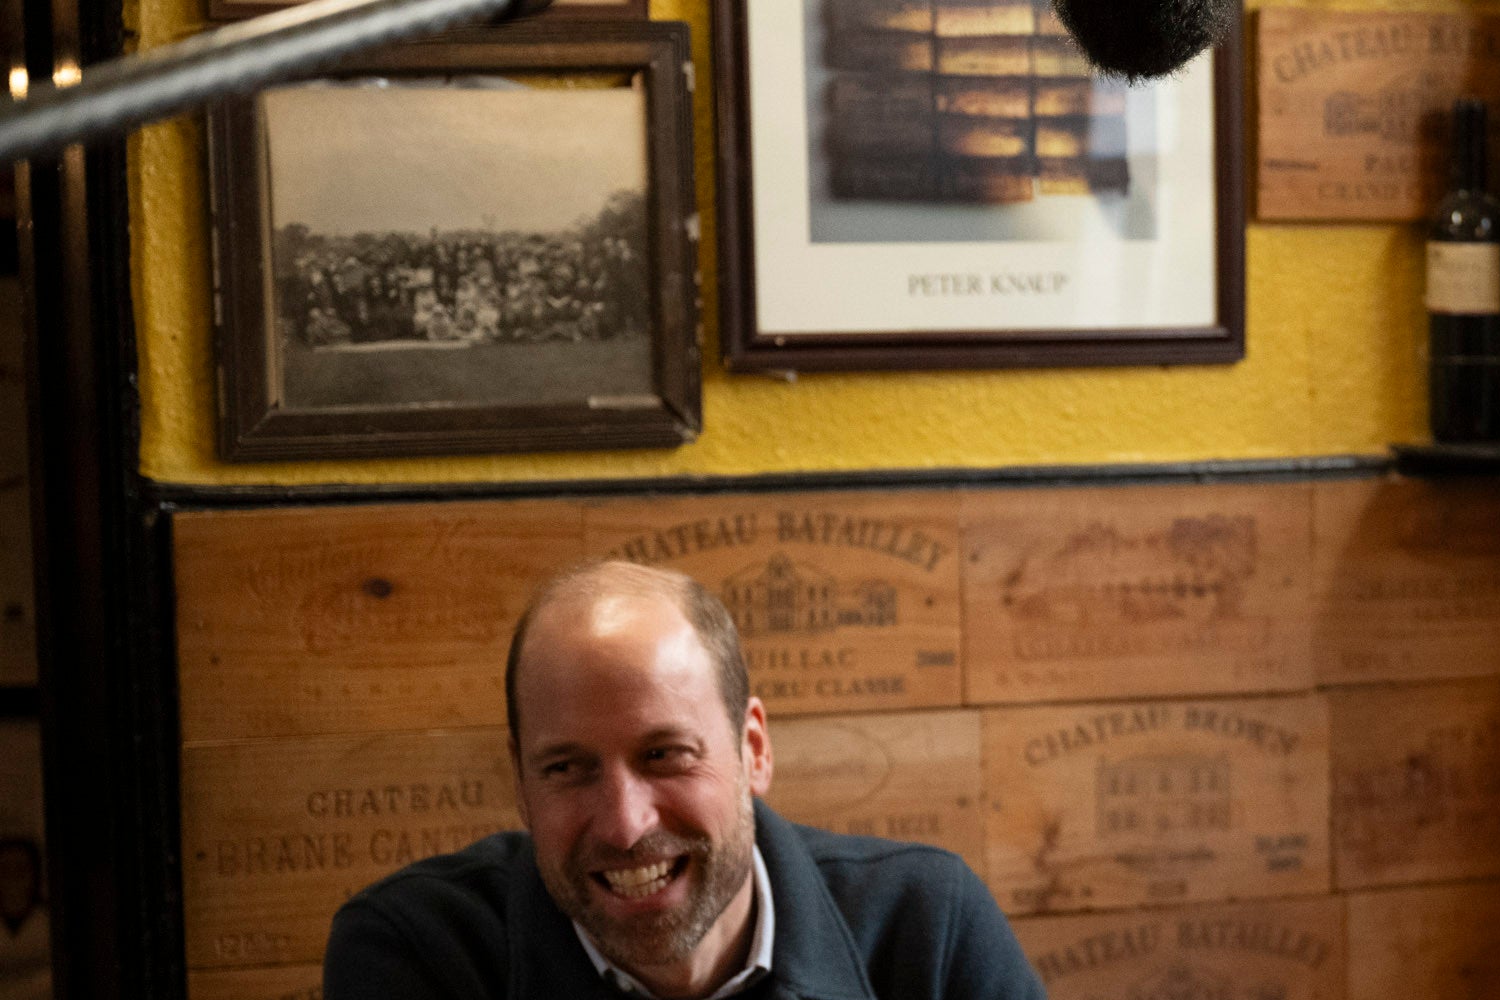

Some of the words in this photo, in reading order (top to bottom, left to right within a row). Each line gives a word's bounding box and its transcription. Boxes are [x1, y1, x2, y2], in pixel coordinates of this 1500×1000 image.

[749, 648, 849, 671] UILLAC
[305, 780, 485, 819] CHATEAU
[1037, 920, 1161, 980] HATEAU
